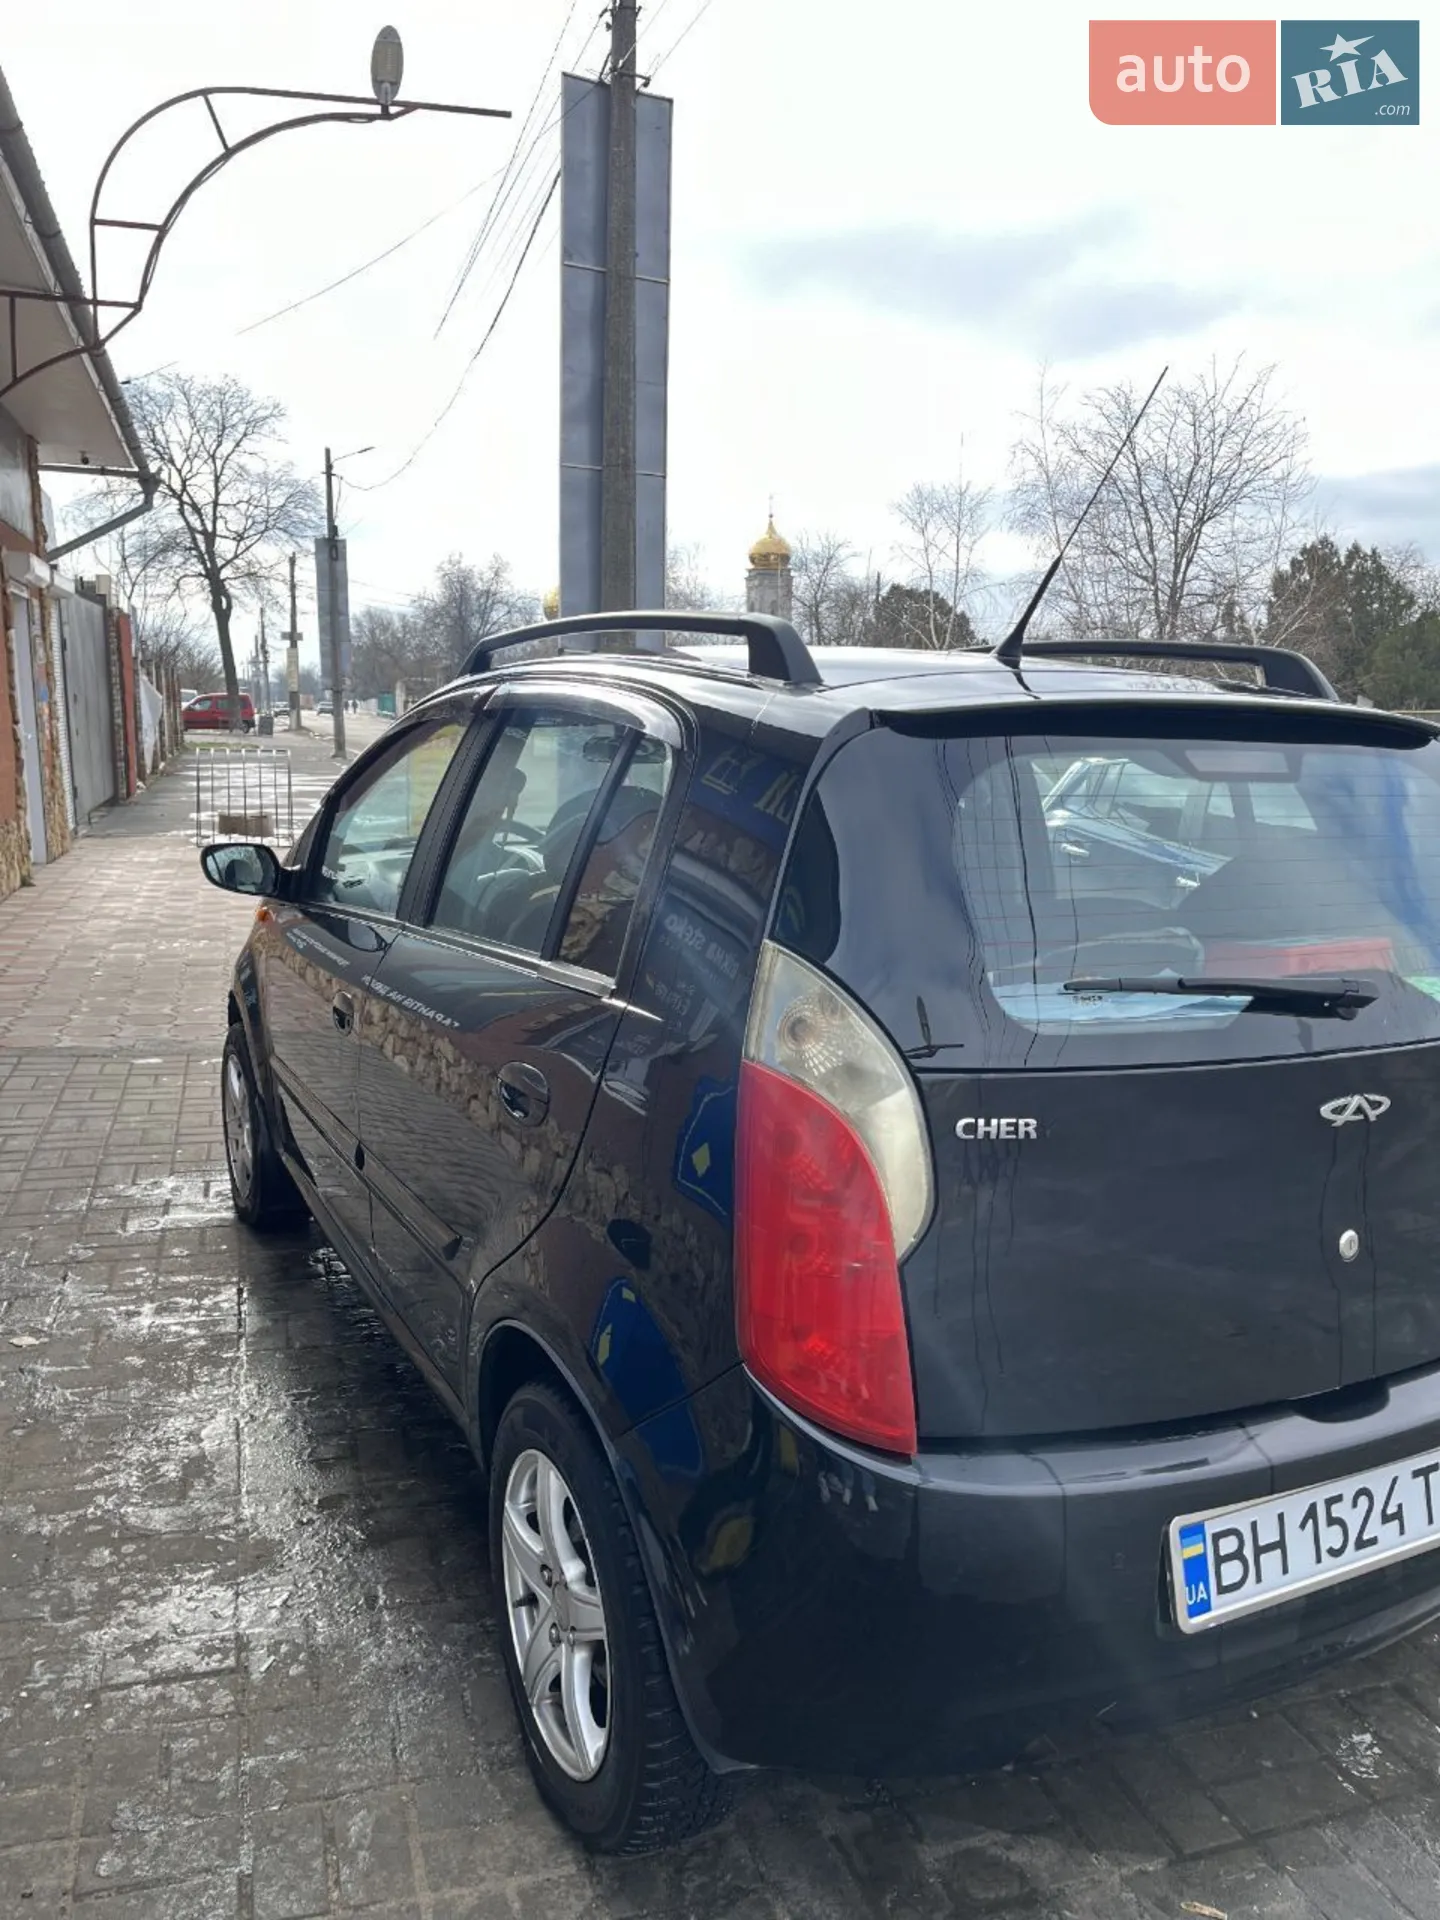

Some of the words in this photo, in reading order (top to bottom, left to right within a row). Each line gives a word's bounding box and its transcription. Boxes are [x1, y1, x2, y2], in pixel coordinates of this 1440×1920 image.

[955, 1117, 1038, 1139] CHER
[1299, 1475, 1405, 1564] 1524
[1184, 1580, 1208, 1606] UA
